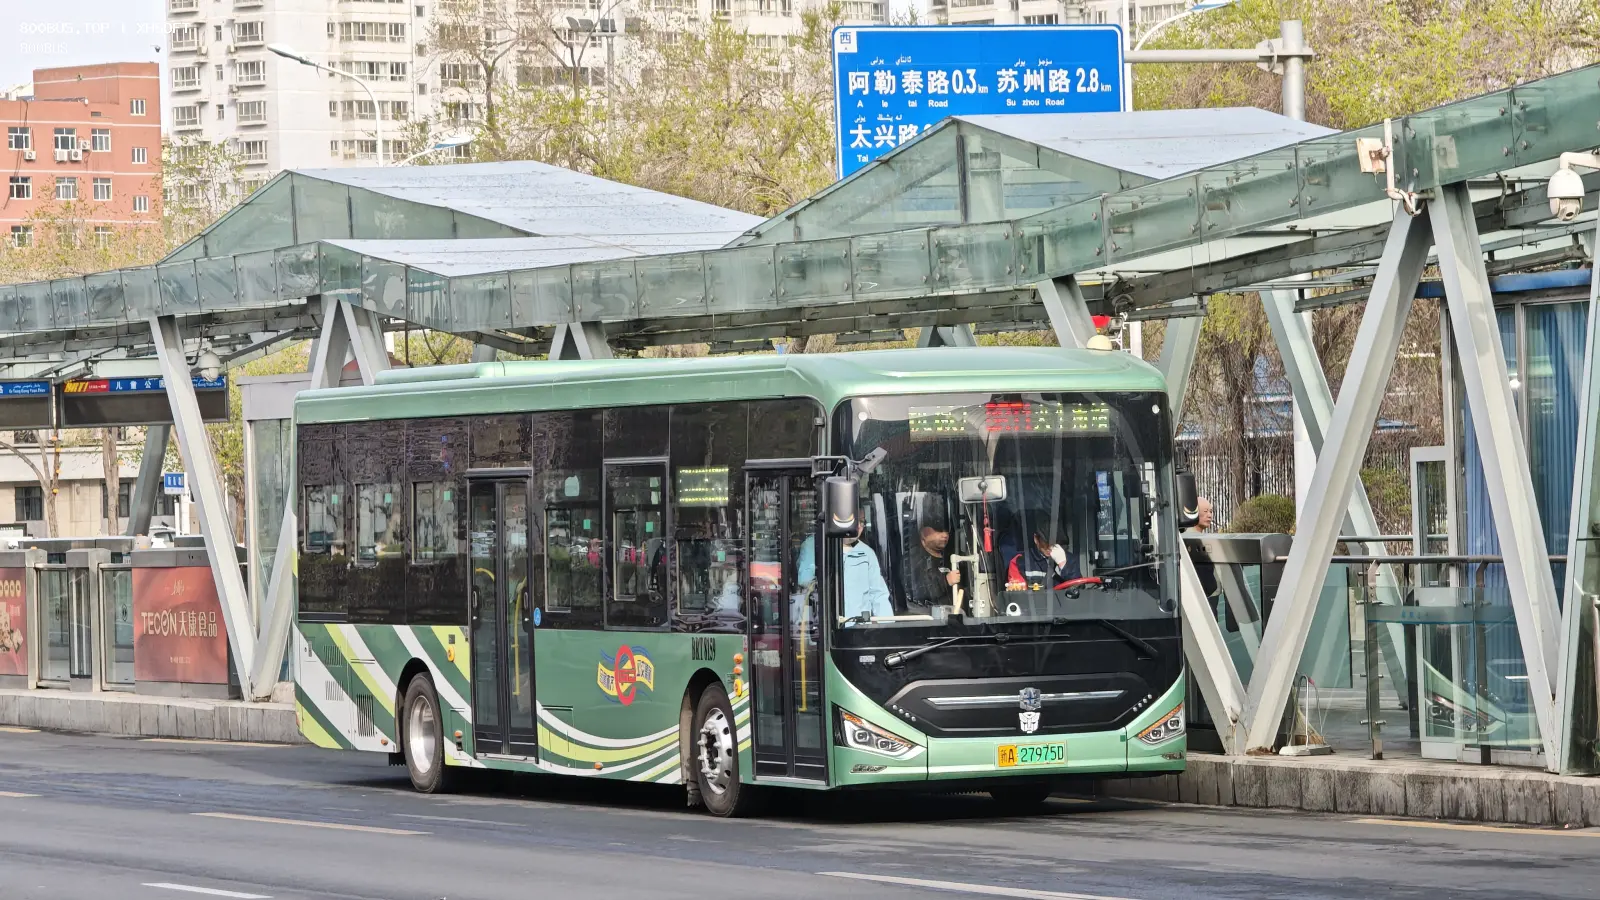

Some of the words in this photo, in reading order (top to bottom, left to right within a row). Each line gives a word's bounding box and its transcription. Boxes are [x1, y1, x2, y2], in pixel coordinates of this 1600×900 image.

[840, 31, 851, 44] 西
[848, 69, 949, 95] 阿勒泰路
[996, 68, 1071, 93] 苏州路
[857, 100, 864, 108] A
[882, 100, 889, 108] le
[908, 100, 918, 108] tai
[928, 99, 949, 108] Road
[1006, 98, 1017, 107] Su
[1022, 98, 1040, 106] zhou
[1045, 98, 1065, 106] Road
[857, 154, 869, 163] Tai
[178, 610, 218, 637] 天康食品
[1020, 745, 1064, 763] 27975D
